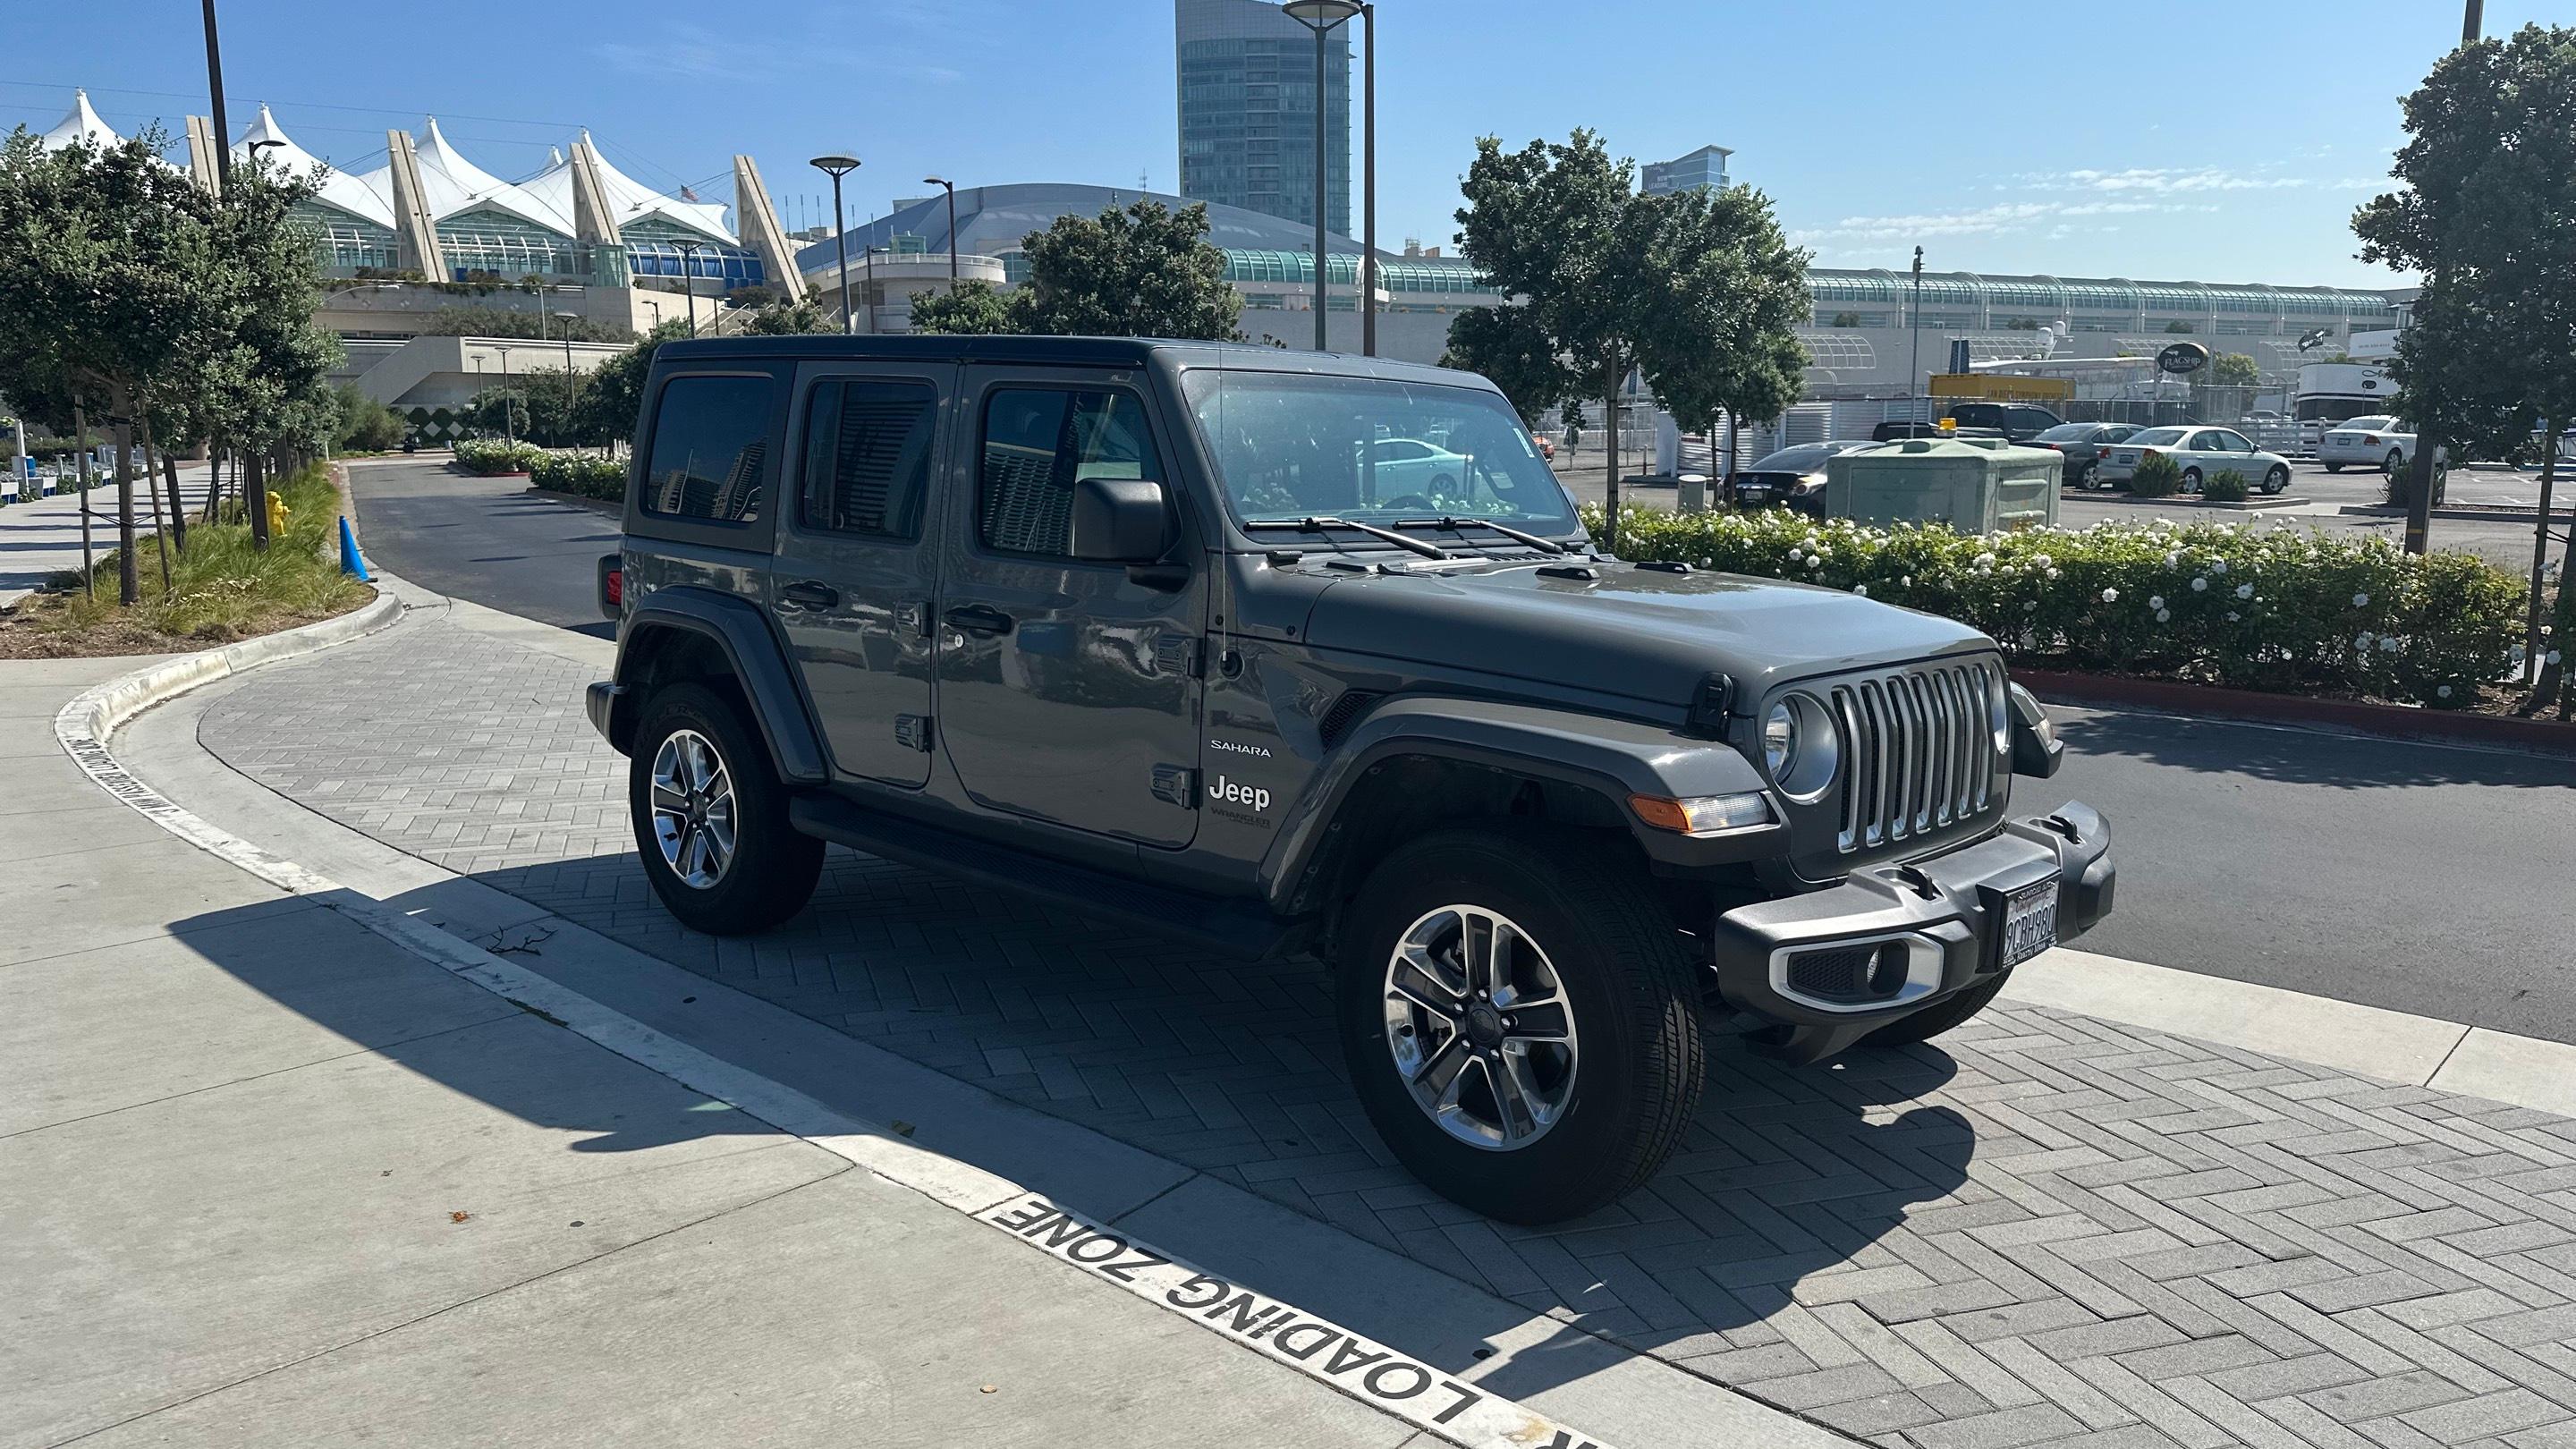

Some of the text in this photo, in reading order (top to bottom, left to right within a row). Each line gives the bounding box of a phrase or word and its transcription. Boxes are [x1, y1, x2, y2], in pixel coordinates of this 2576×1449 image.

[1210, 740, 1272, 758] SAHARA
[1208, 775, 1271, 812] Jeep
[2004, 903, 2056, 957] 9CBH980
[991, 1200, 1483, 1424] LOADING ZONE
